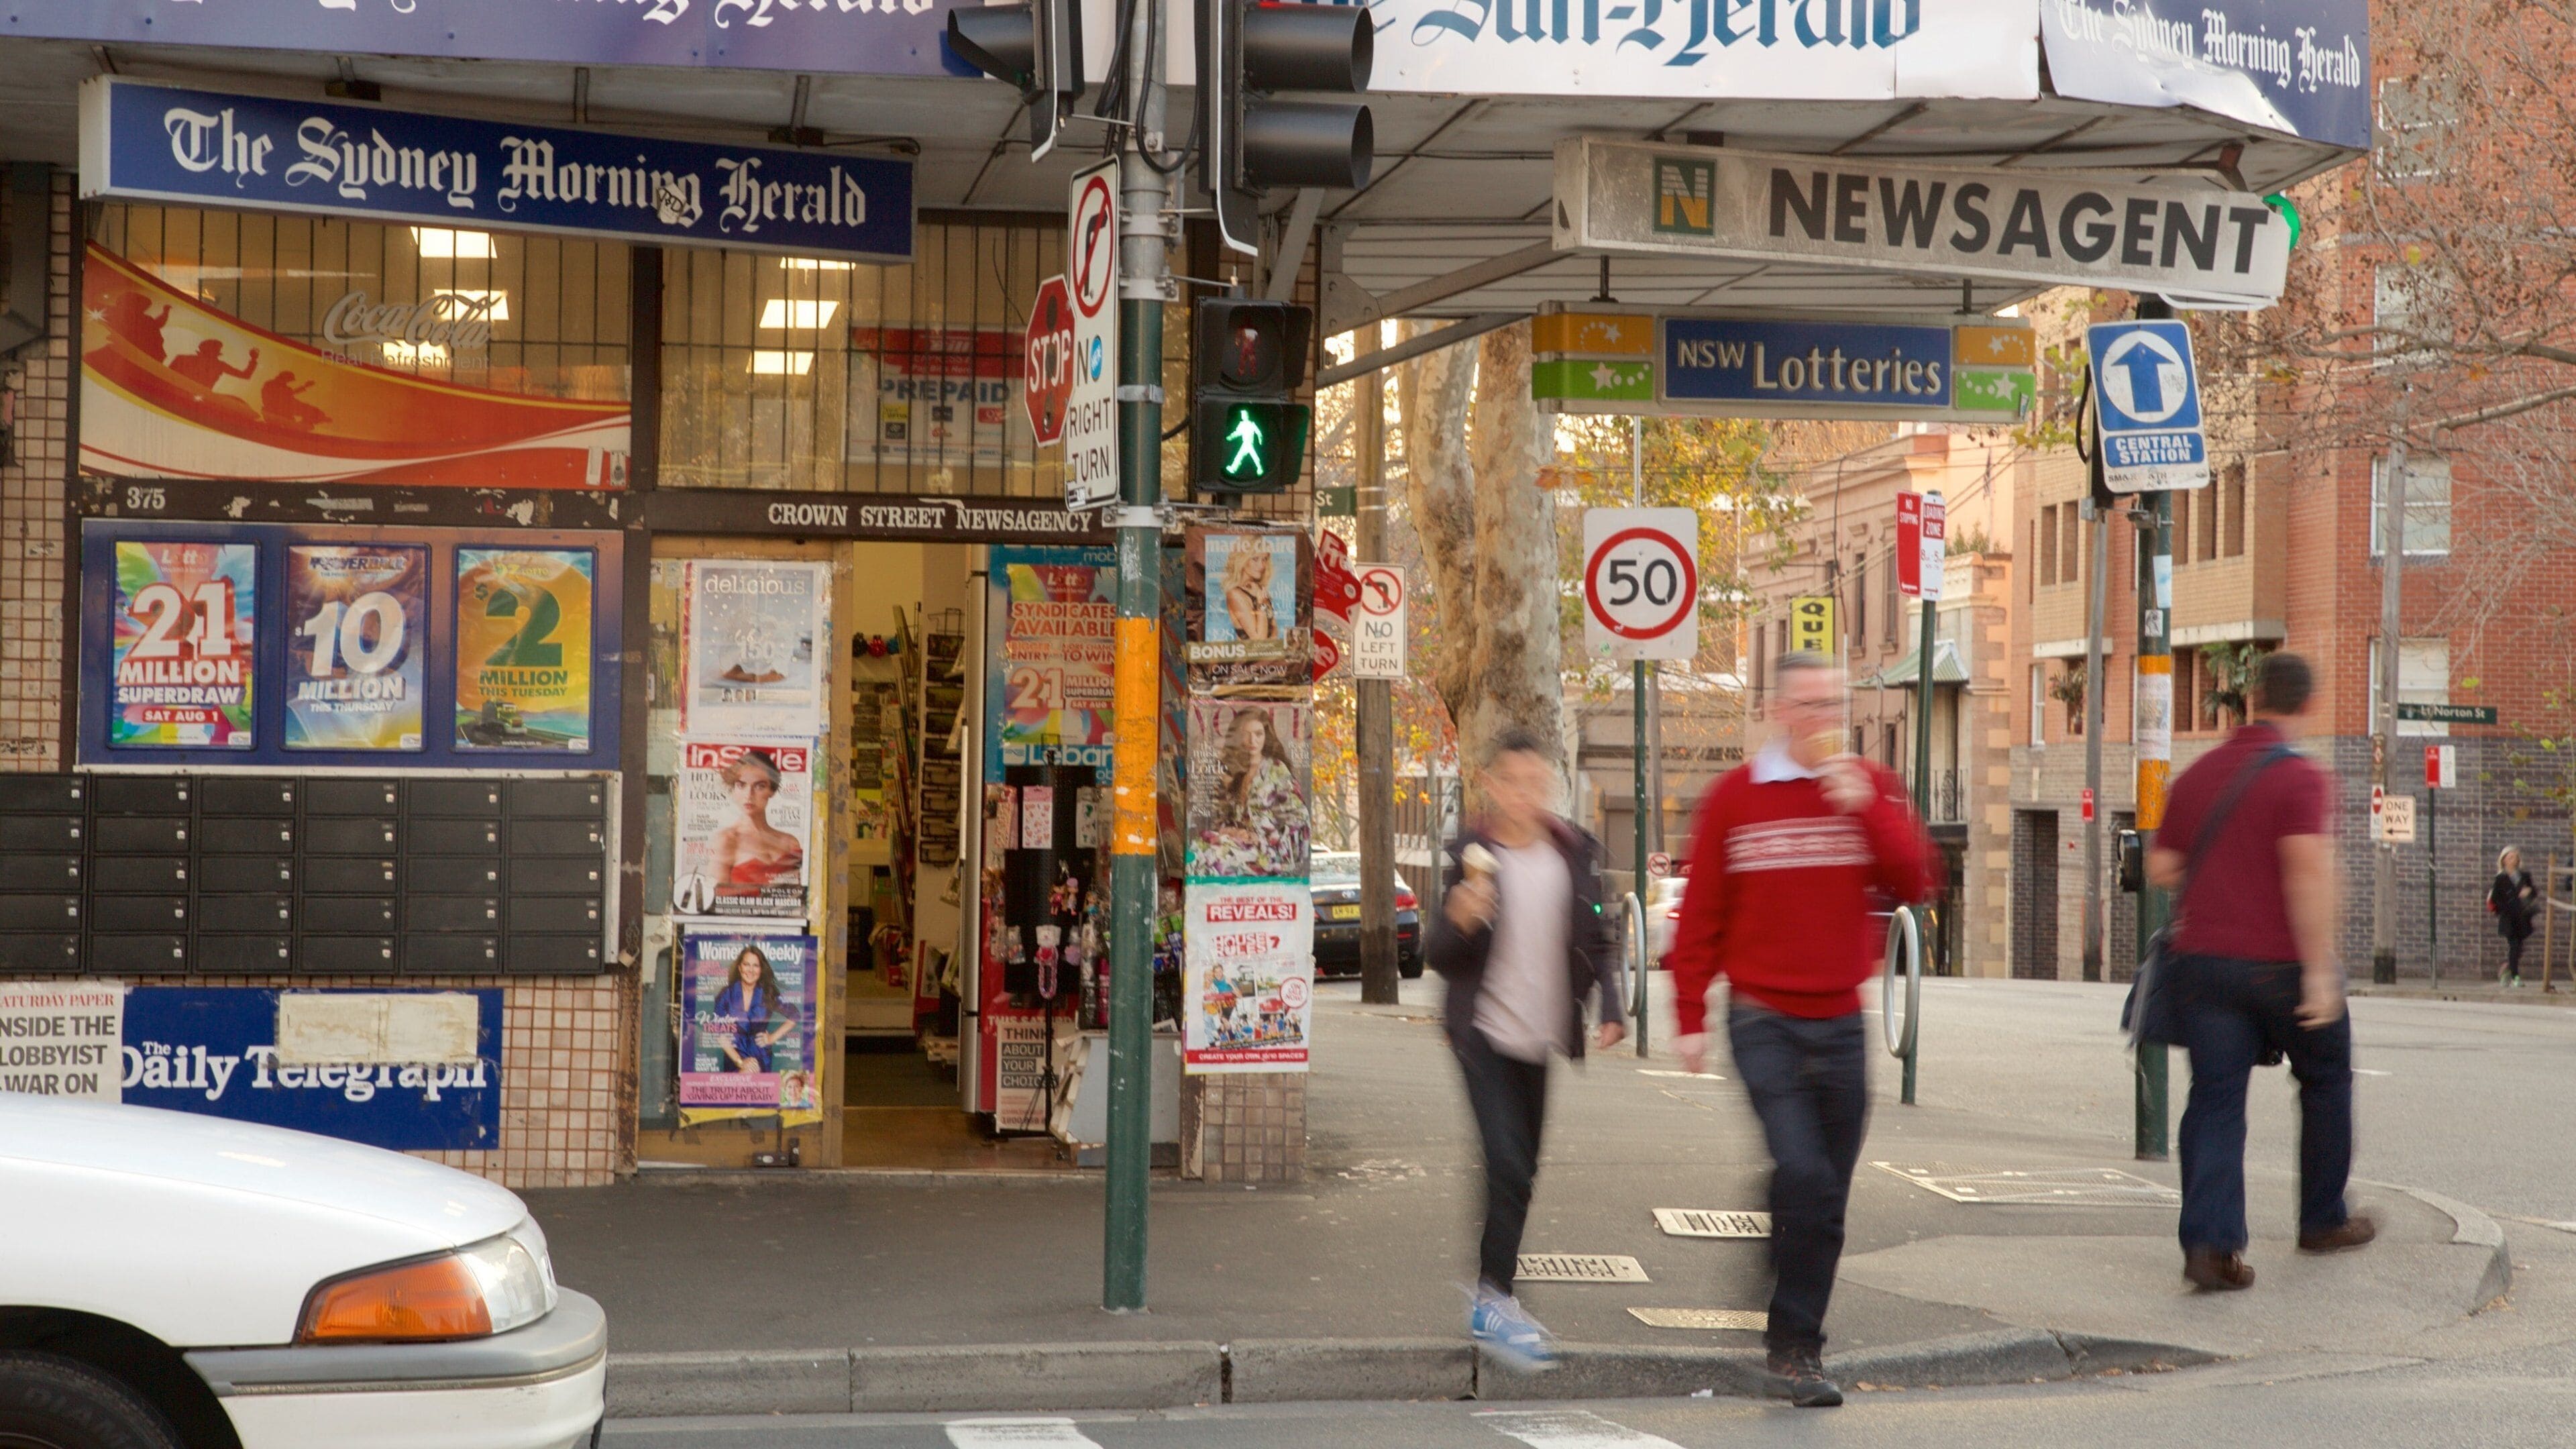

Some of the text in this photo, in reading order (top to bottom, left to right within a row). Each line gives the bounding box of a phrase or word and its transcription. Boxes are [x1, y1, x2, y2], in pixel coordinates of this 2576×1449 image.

[2202, 8, 2291, 89] Morning
[2295, 25, 2361, 93] Herald
[164, 107, 865, 233] The Sydney Morning Herald
[1769, 168, 2269, 274] NEWSAGENT
[322, 350, 489, 368] Real Refreshment
[1029, 329, 1072, 393] STOP
[1076, 336, 1102, 386] N
[1677, 339, 1943, 395] NSW Lotteries
[881, 378, 1010, 402] PREPAID
[1069, 397, 1111, 437] RIGHT
[2115, 435, 2192, 451] CENTRAL
[1072, 445, 1110, 484] TURN
[2119, 449, 2191, 464] STATION
[126, 486, 166, 511] 375
[1316, 490, 1333, 507] St
[768, 502, 1093, 533] CROWN STREET NEWSAGENCY
[1926, 521, 1943, 536] ZONE
[1205, 539, 1295, 553] marie claire
[1609, 557, 1678, 606] 50
[1012, 603, 1117, 619] SYNDICATES
[1365, 621, 1393, 637] NO
[1190, 645, 1246, 659] BONUS
[1361, 642, 1395, 653] LEFT
[1360, 658, 1398, 669] TURN
[118, 660, 240, 684] MILLION
[479, 669, 568, 686] MILLION
[117, 686, 240, 704] SUPERDRAW
[297, 676, 407, 700] MILLION
[478, 688, 568, 697] THIS TUESDAY
[144, 708, 219, 722] SAT AUG 1
[310, 702, 394, 712] THIS THURSDAY
[2434, 706, 2473, 718] Norton
[2475, 708, 2486, 719] St
[691, 744, 803, 771] InSle
[691, 771, 714, 782] HOT
[690, 791, 727, 800] LOOKS
[2386, 802, 2409, 811] ONE
[2385, 814, 2410, 825] WAY
[774, 897, 802, 907] MASCARA
[1210, 905, 1294, 920] REVEALS!
[755, 941, 804, 965] Weekly
[70, 994, 114, 1006] PAPER
[0, 1015, 115, 1037] NSIDE THE
[0, 1044, 108, 1066] LOBBYIST
[142, 1041, 171, 1055] The
[1002, 1044, 1044, 1056] ABOUT
[122, 1045, 239, 1102] Daily
[1002, 1060, 1035, 1071] YOUR
[4, 1073, 98, 1095] WAR ON
[710, 1086, 739, 1094] TRUTH
